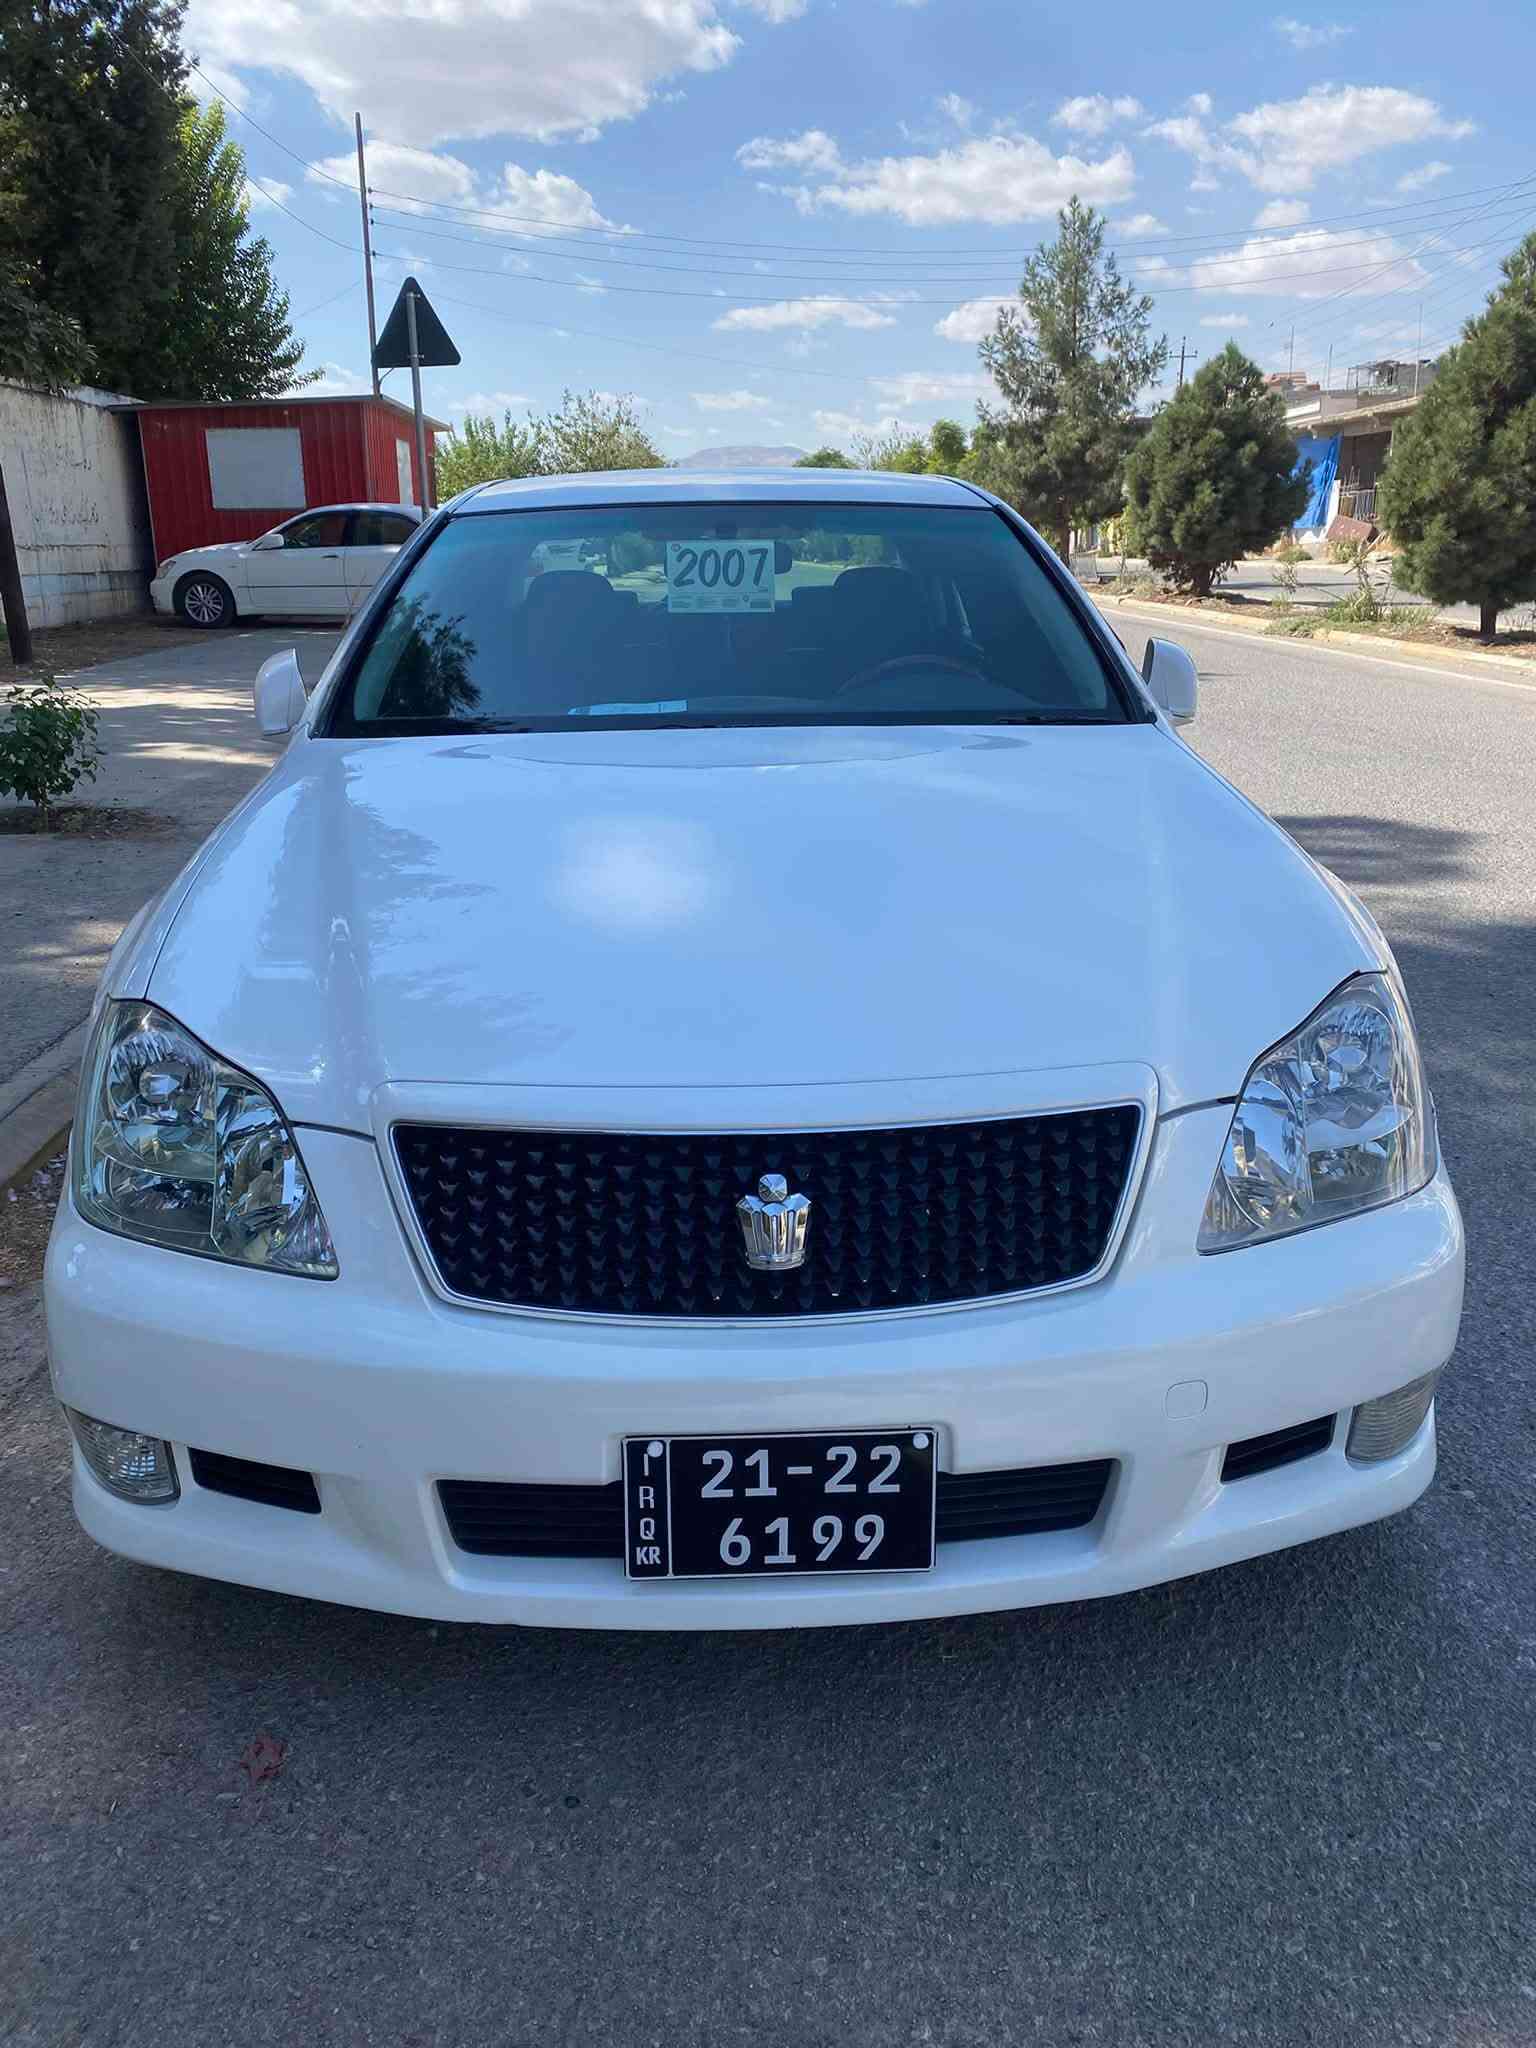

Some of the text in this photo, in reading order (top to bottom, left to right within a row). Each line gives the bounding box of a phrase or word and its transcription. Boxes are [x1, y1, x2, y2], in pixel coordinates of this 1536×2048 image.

[673, 548, 769, 588] 2007
[701, 1445, 901, 1499] 21-22
[635, 1546, 662, 1566] KR
[719, 1514, 885, 1566] 6199
